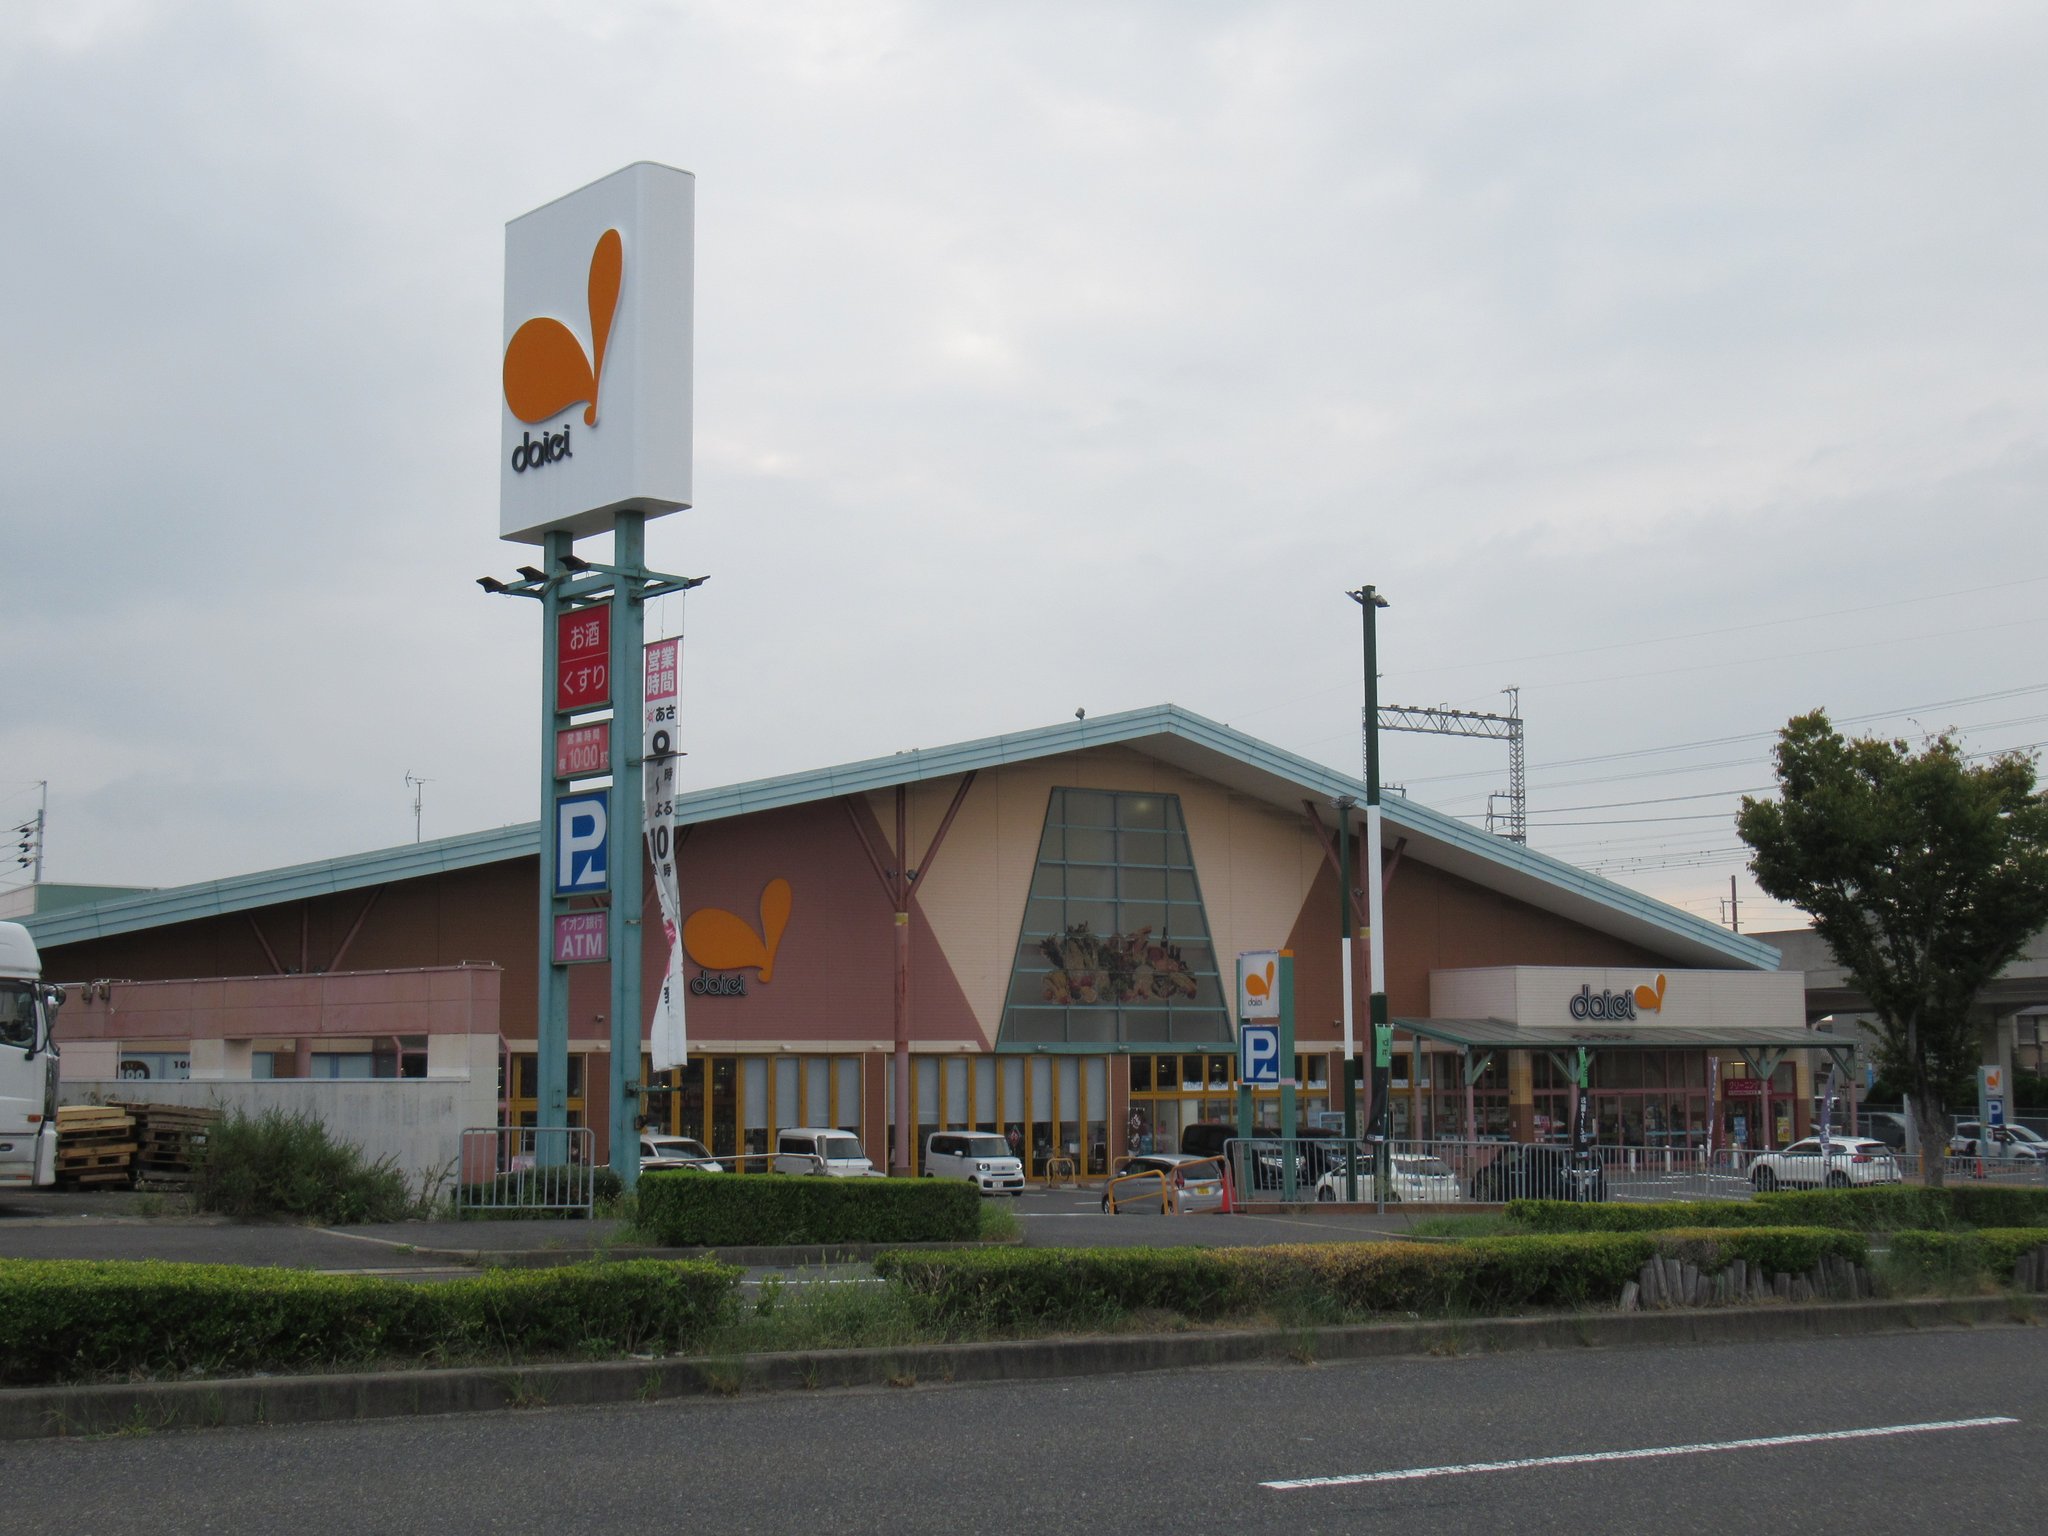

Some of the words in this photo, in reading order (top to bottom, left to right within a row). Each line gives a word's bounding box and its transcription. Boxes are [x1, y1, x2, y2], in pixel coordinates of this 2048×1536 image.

[511, 424, 573, 473] daiei
[570, 621, 600, 650] お酒
[648, 648, 674, 672] 営業
[563, 666, 605, 695] くすり
[647, 671, 674, 696] 時間
[655, 706, 676, 722] あさ
[570, 744, 598, 769] 10:00
[655, 801, 673, 818] よる
[559, 799, 607, 887] P
[561, 914, 603, 931] イオン銀行
[561, 933, 603, 958] ATM
[690, 970, 748, 997] daiei
[1570, 984, 1637, 1021] daiei
[1245, 1030, 1277, 1079] P
[1987, 1101, 2002, 1124] P
